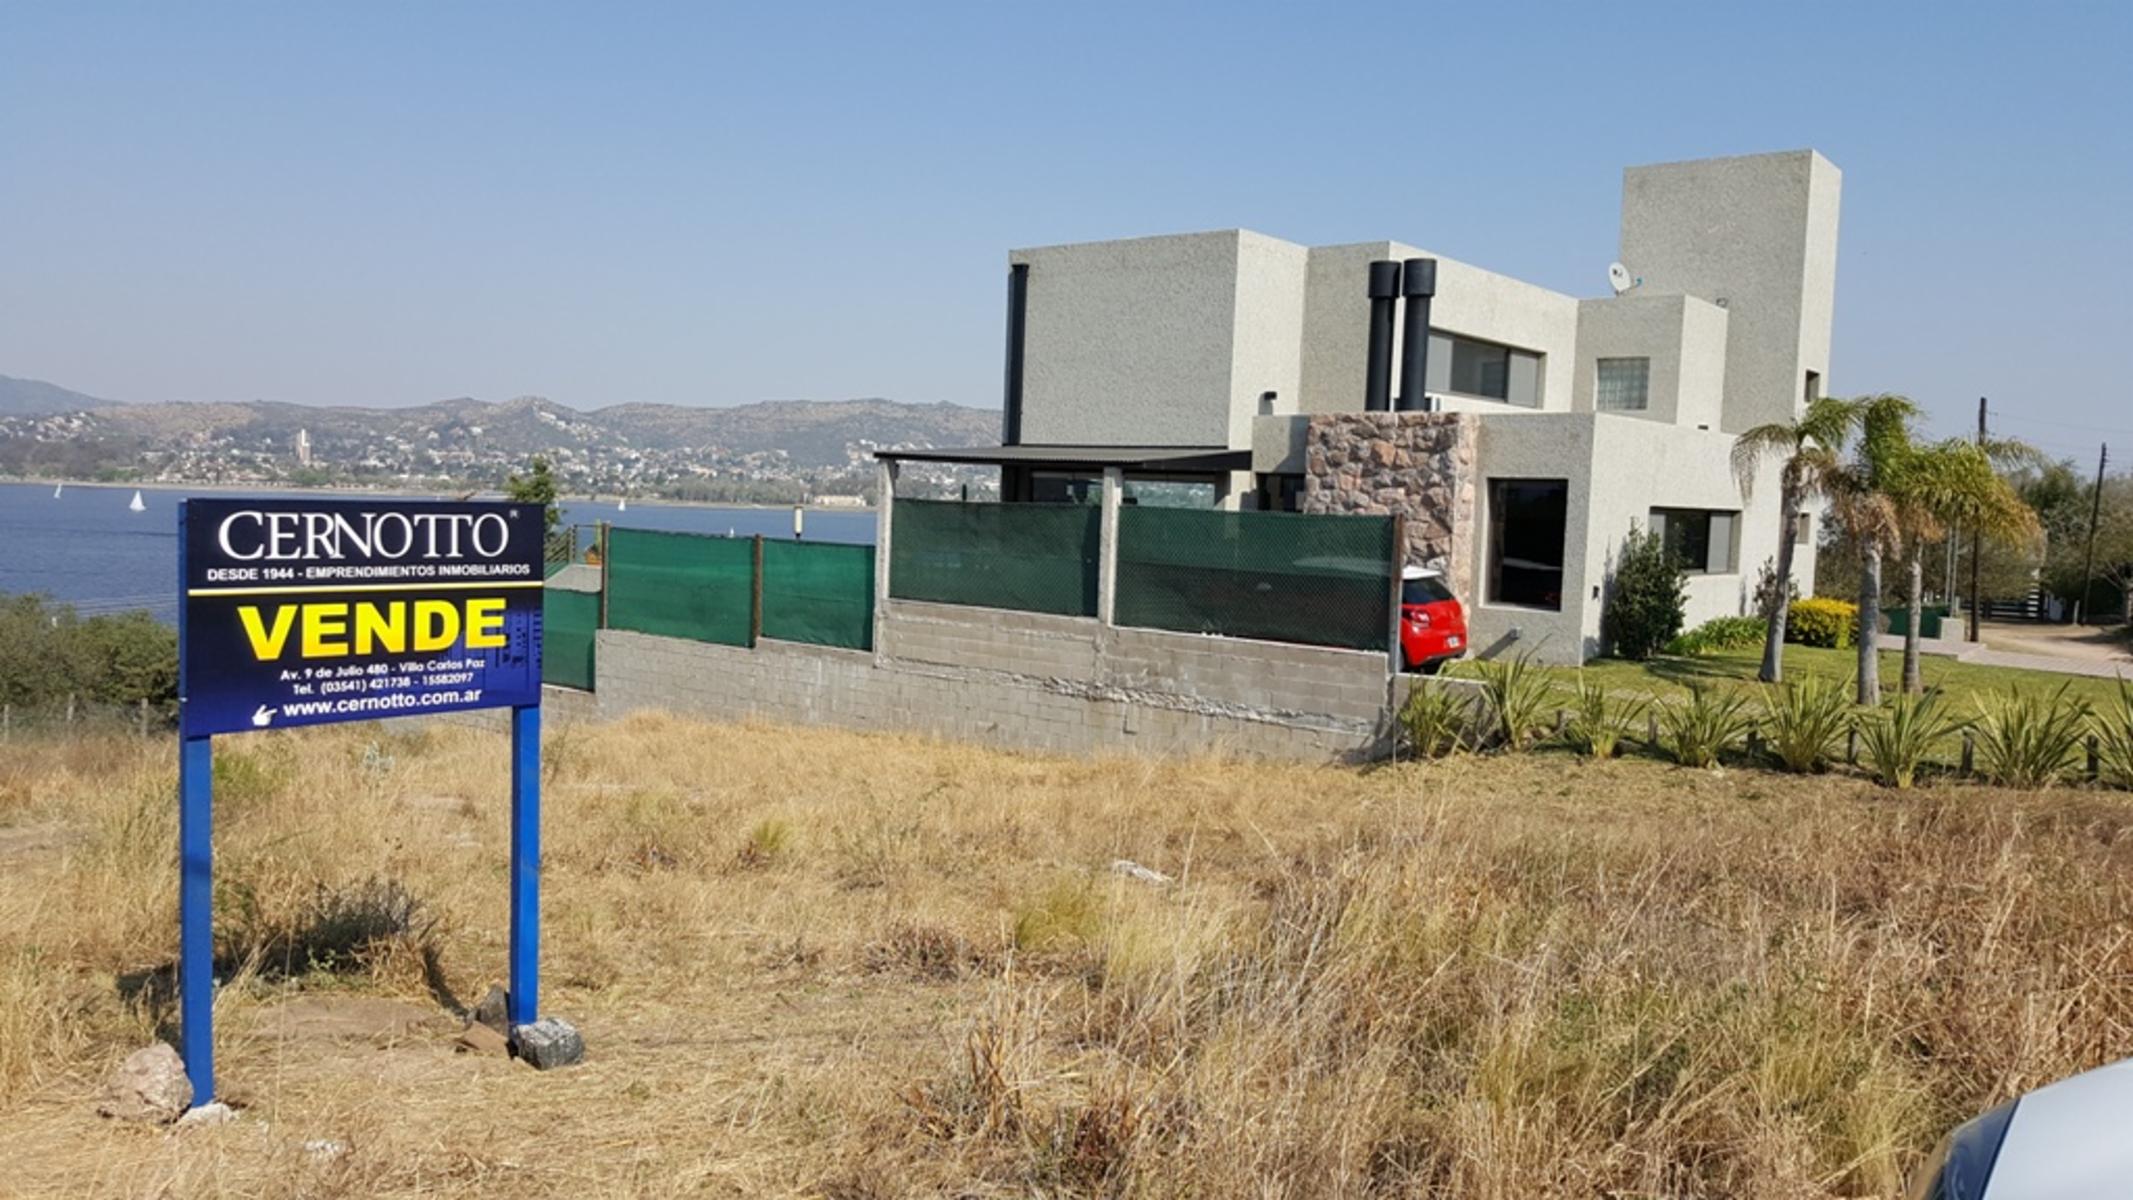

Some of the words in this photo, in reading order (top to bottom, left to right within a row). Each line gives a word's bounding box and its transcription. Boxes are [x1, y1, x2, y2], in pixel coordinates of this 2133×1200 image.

[218, 510, 509, 560] CERNOTTO
[207, 568, 259, 581] DESDE
[262, 567, 295, 580] 1944
[305, 565, 436, 579] EMPRENDIMIENTOS
[438, 564, 531, 577] INMOBILIARIOS
[237, 598, 507, 661] VENDE
[280, 670, 301, 681] Av.
[304, 668, 313, 679] 9
[315, 667, 332, 679] de
[336, 665, 364, 678] Julio
[367, 663, 388, 675] 480
[399, 661, 424, 673] Villa
[427, 660, 463, 671] Carlos
[465, 658, 485, 669] Paz
[292, 684, 314, 695] Tel.
[320, 679, 367, 695] (03541)
[283, 689, 482, 717] www.cernotto.com.ar
